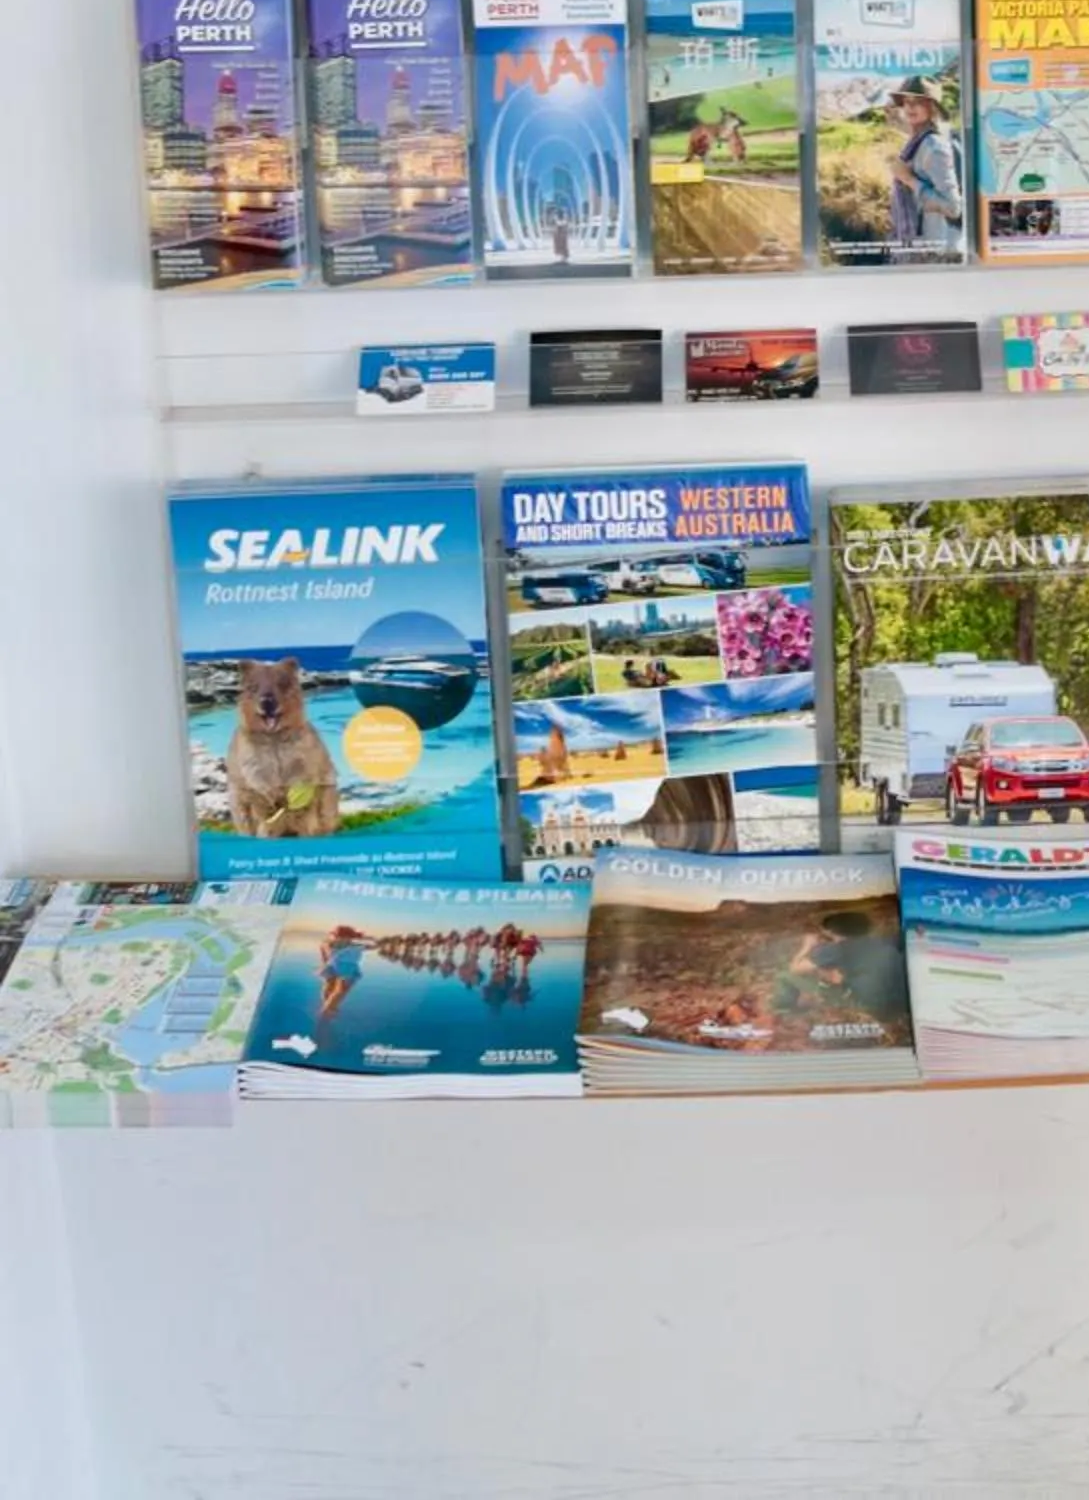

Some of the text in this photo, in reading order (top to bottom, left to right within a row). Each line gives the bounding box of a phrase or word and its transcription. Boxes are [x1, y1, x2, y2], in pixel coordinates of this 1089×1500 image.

[487, 3, 540, 17] PERTH
[988, 0, 1064, 17] VICTORIA
[176, 24, 252, 43] PERTH
[349, 21, 424, 40] PERTH
[493, 33, 619, 104] MAP
[828, 45, 945, 70] SOUTH WEST
[512, 488, 668, 525] DAY TOURS
[679, 485, 787, 513] WESTERN
[516, 520, 668, 544] AND SHORT BREAKS
[675, 509, 796, 538] AUSTRALIA
[203, 522, 447, 575] SEALINK
[205, 577, 374, 605] Rottnest Island
[609, 857, 866, 888] GOLDEN OUTBACK
[315, 878, 455, 902] KIMBERLEY
